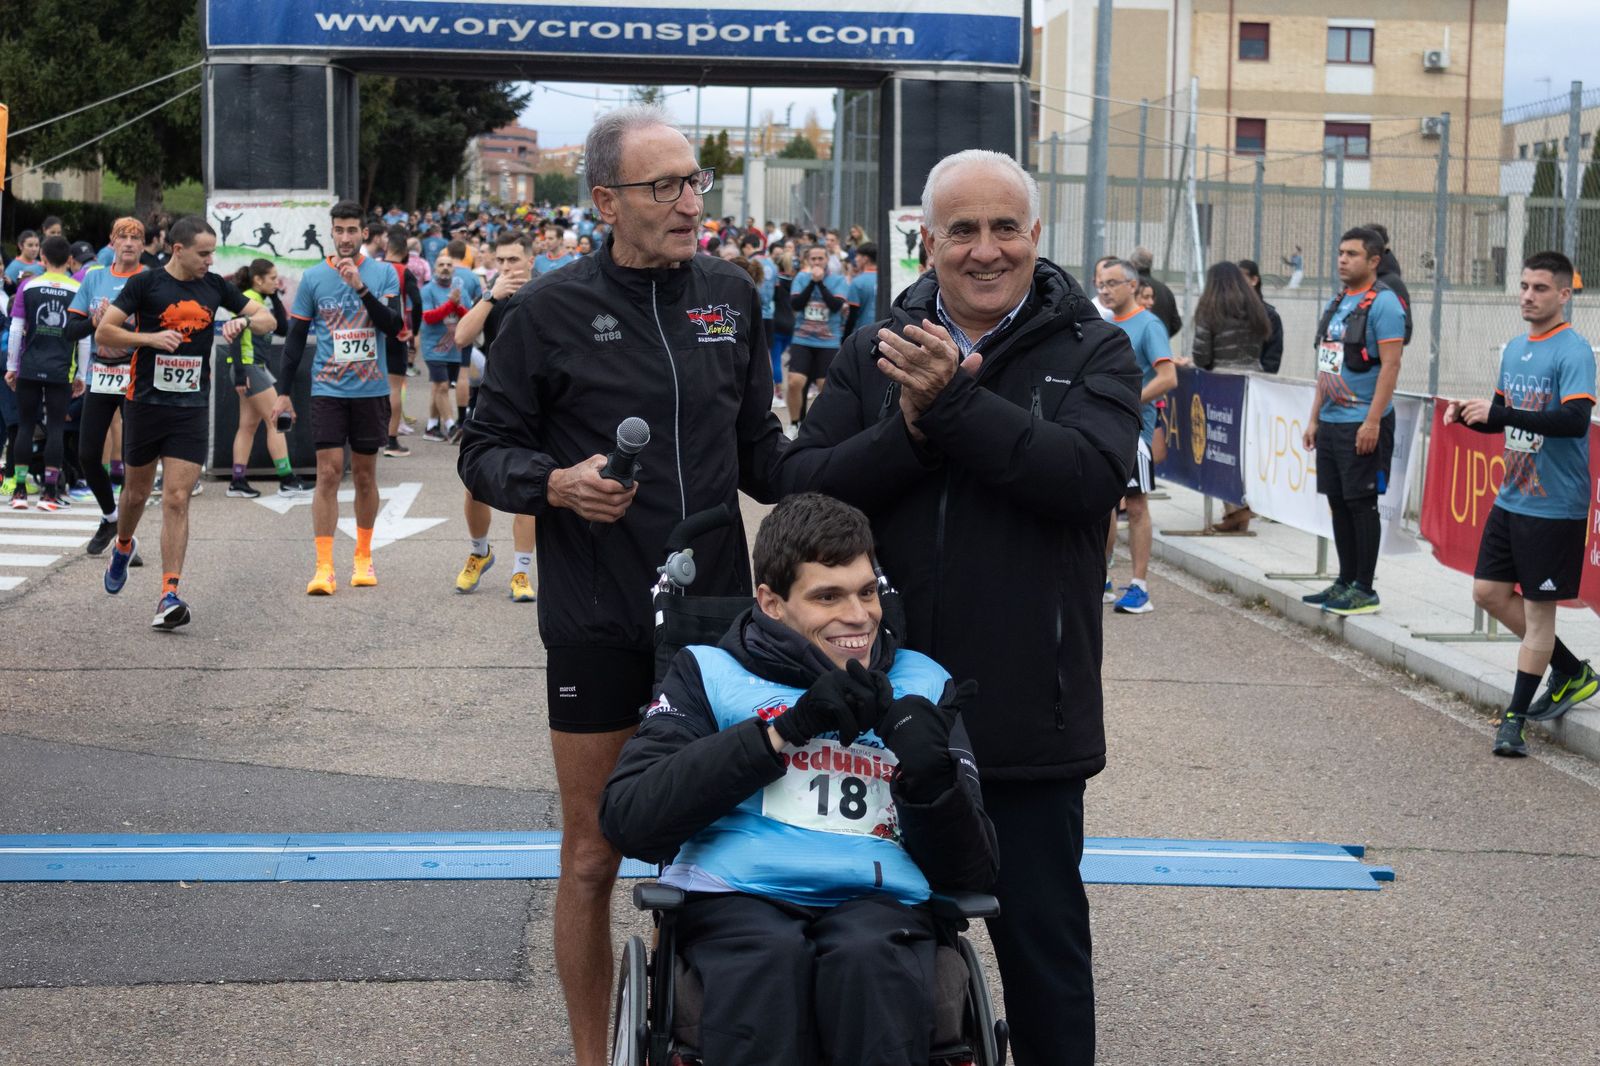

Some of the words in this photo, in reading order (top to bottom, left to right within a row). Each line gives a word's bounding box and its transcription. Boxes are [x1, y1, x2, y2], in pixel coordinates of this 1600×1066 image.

[315, 12, 915, 47] www.orycronsport.com
[40, 287, 68, 297] CARLOS
[342, 339, 370, 354] 376
[98, 373, 124, 387] 779
[163, 367, 194, 384] 592
[809, 773, 868, 820] 18
